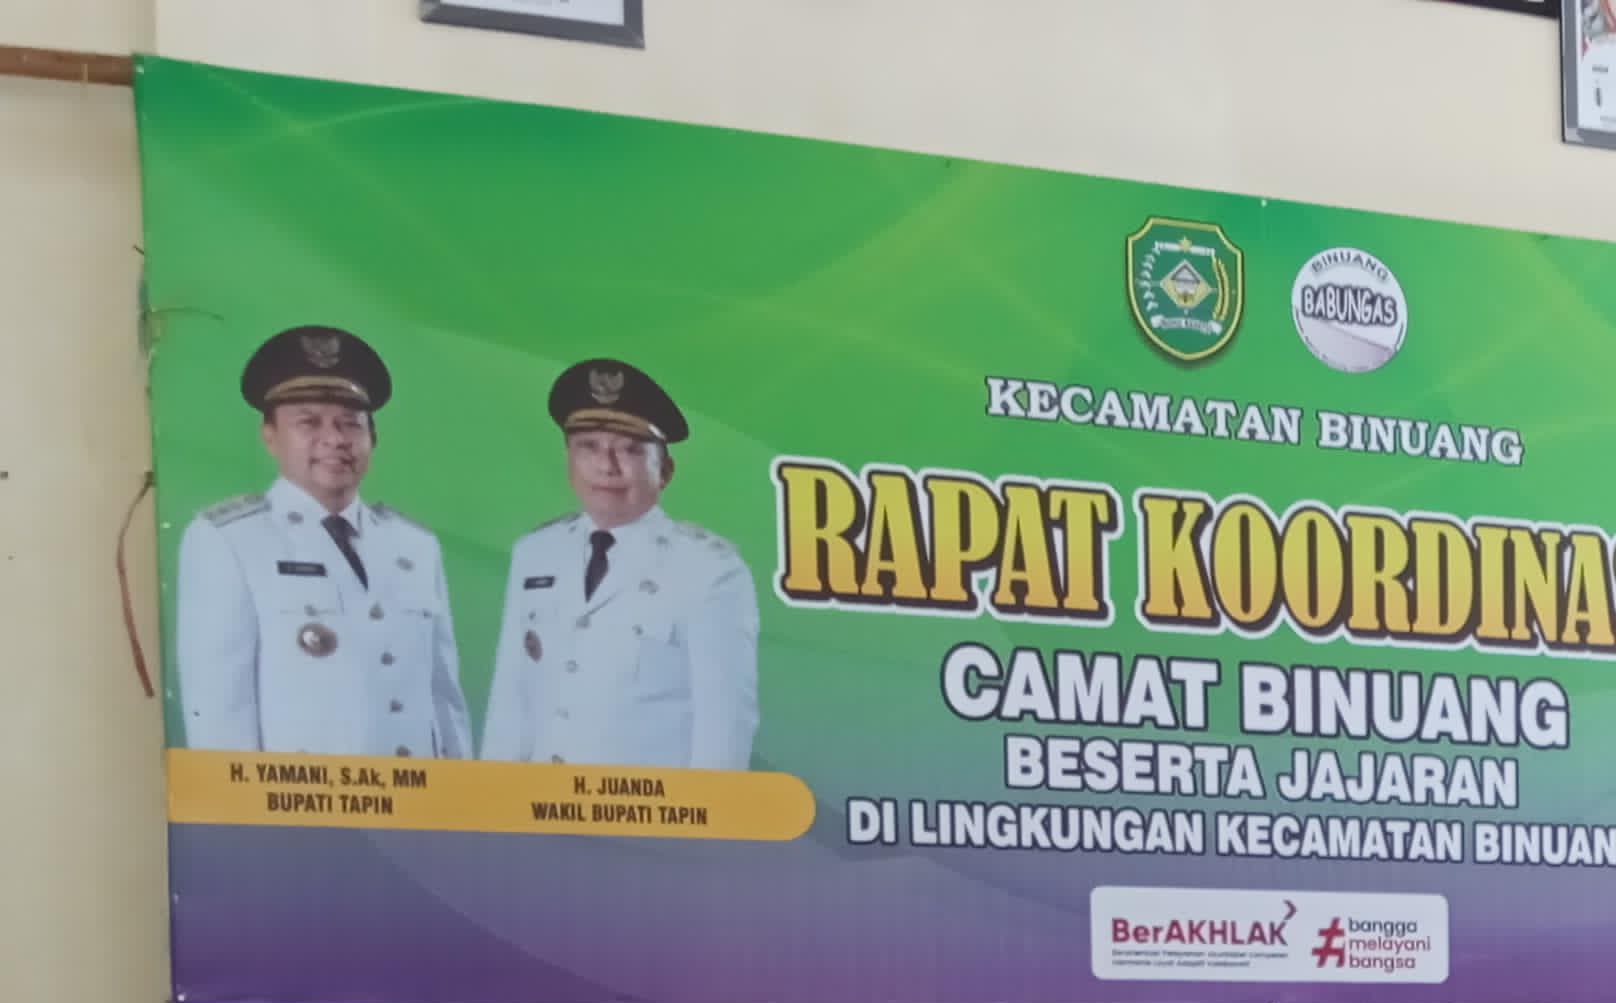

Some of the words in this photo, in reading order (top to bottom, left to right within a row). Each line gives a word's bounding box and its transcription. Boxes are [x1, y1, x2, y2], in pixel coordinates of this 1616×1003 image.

[1311, 251, 1388, 282] BINUANG
[1302, 284, 1398, 326] BABUNGAS
[985, 376, 1303, 444] KECAMATAN
[1317, 409, 1524, 467] BINUANG
[775, 460, 1121, 622] RAPAT
[941, 642, 1219, 731] CAMAT
[1240, 662, 1569, 748] BINUANG
[230, 763, 249, 783] H.
[256, 764, 334, 788] YAMANI,
[340, 767, 386, 788] S.Ak,
[393, 769, 427, 788] MM
[1005, 735, 1266, 798] BESERTA
[1276, 749, 1519, 808] JAJARAN
[574, 776, 592, 795] H.
[597, 777, 666, 797] JUANDA
[267, 792, 333, 813] BUPATI
[339, 795, 393, 814] TAPIN
[531, 802, 587, 822] WAKIL
[592, 804, 653, 823] BUPATI
[657, 806, 708, 825] TAPIN
[847, 797, 898, 844] DI
[909, 800, 1205, 855] LINGKUNGAN
[1217, 812, 1465, 863] KECAMATAN
[1112, 917, 1288, 946] BerAKHLAK
[1347, 917, 1418, 935] bangga
[1347, 936, 1431, 953] melayani
[1347, 954, 1417, 973] bangsa
